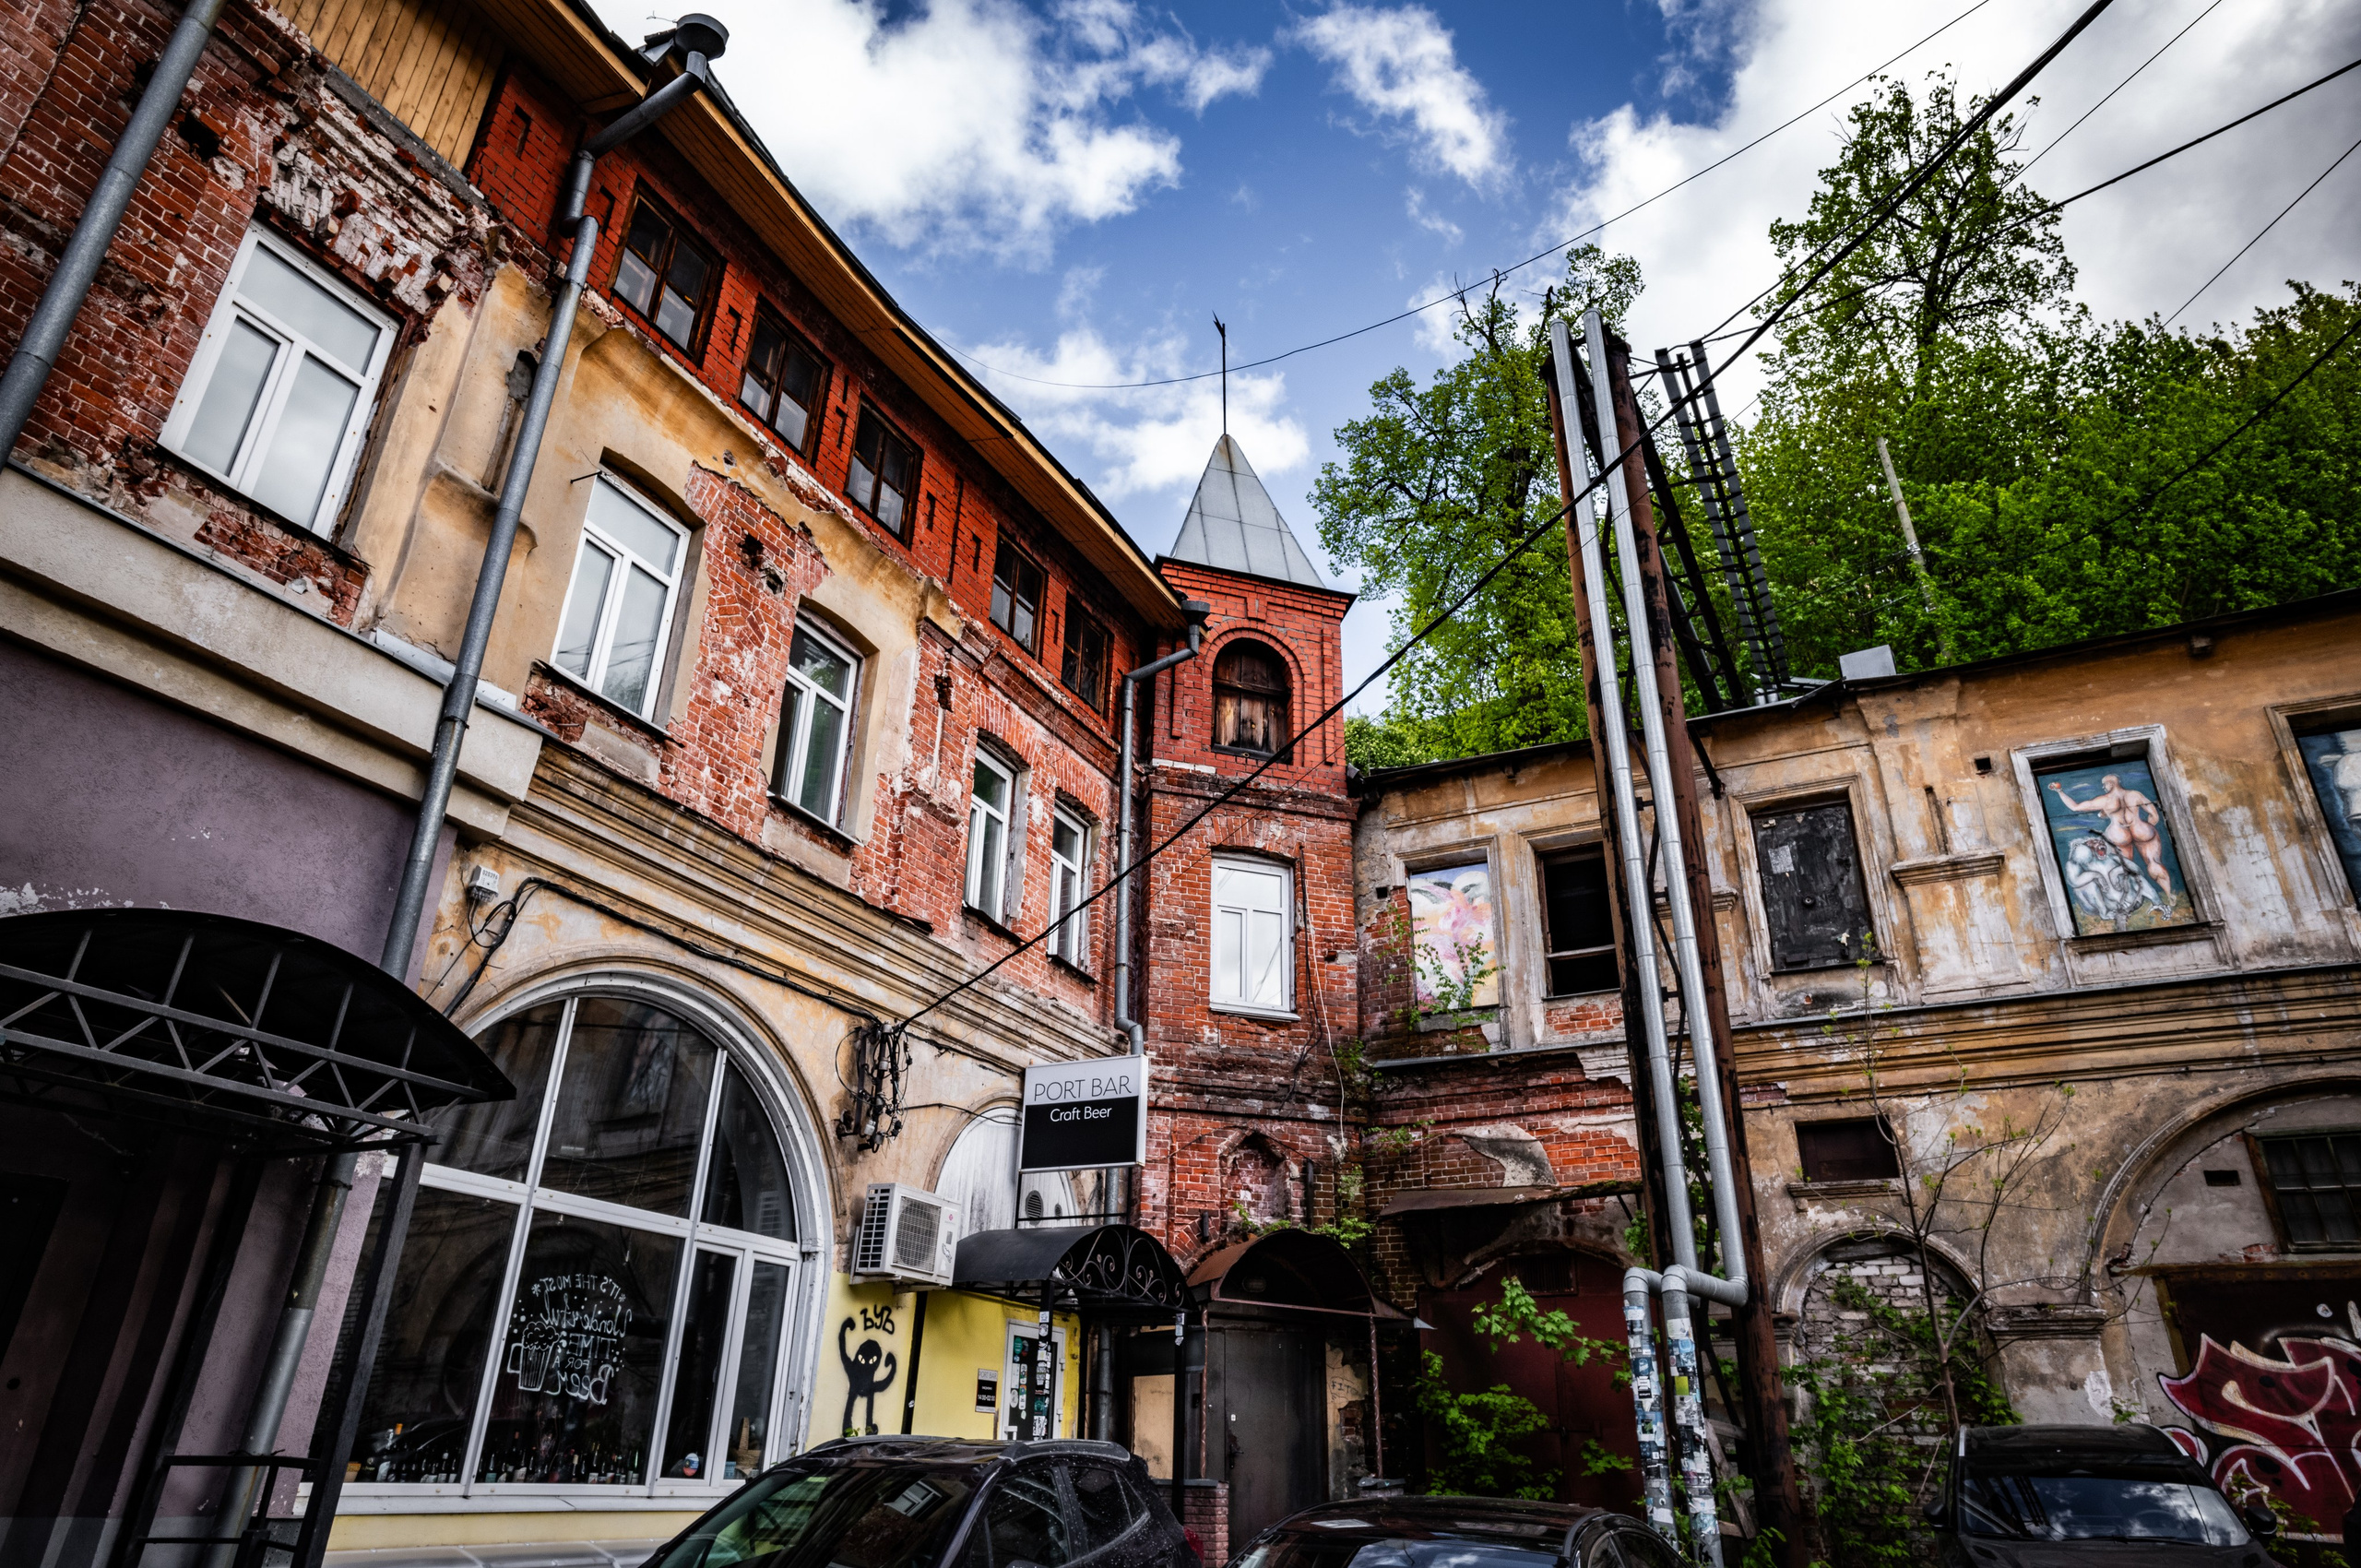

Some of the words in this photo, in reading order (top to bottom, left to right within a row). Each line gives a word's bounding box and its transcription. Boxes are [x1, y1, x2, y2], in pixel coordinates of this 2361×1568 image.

[1034, 1079, 1086, 1102] PORT
[1091, 1075, 1133, 1098] BAR
[1050, 1107, 1081, 1123] Craft
[1084, 1106, 1112, 1120] Beer
[979, 1371, 989, 1379] PORT
